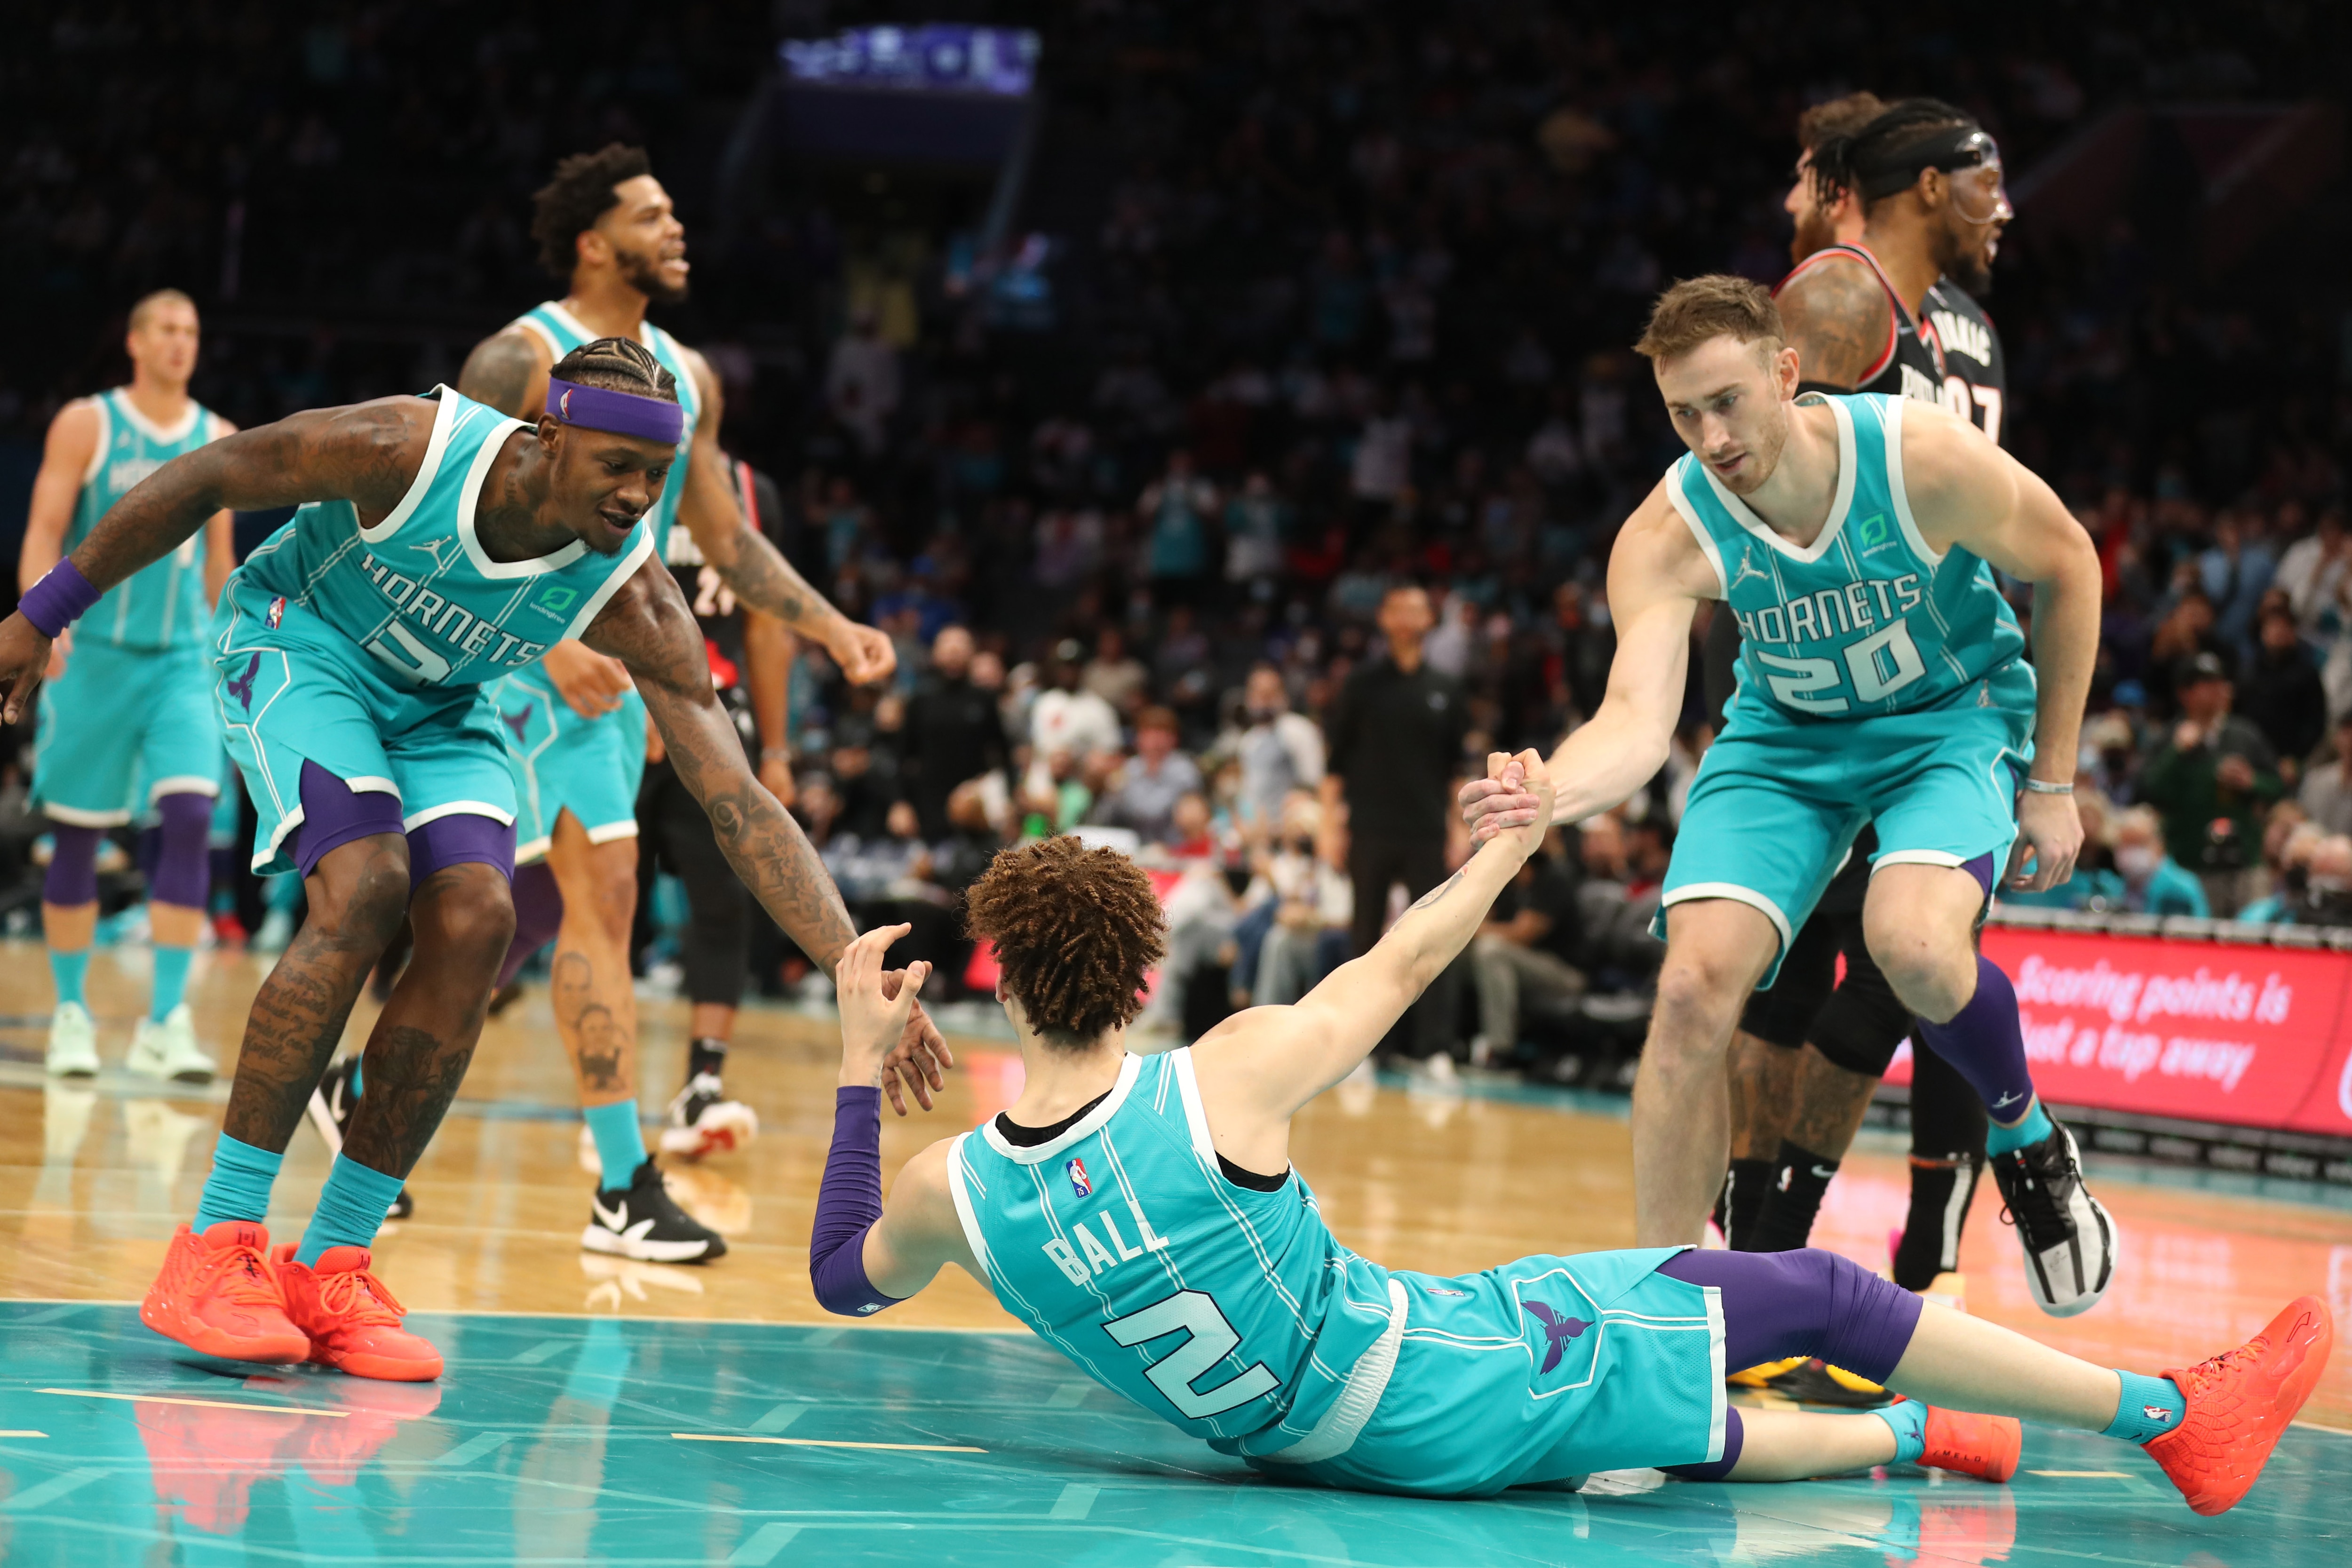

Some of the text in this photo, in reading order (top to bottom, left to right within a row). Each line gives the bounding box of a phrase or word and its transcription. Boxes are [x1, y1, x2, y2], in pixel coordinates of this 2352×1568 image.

[362, 553, 546, 666] HORNETS
[529, 602, 565, 624] lendingtree
[1732, 573, 1923, 644] HORNETS
[1755, 617, 1927, 713] 20
[2016, 955, 2292, 1024] Scoring points is
[2070, 1028, 2098, 1067] a
[2098, 1022, 2162, 1082] tap
[2160, 1036, 2255, 1094] away
[1077, 1187, 1084, 1196] 75
[1041, 1200, 1169, 1287] BALL
[1100, 1289, 1283, 1420] 2
[1943, 1450, 1981, 1463] MELO
